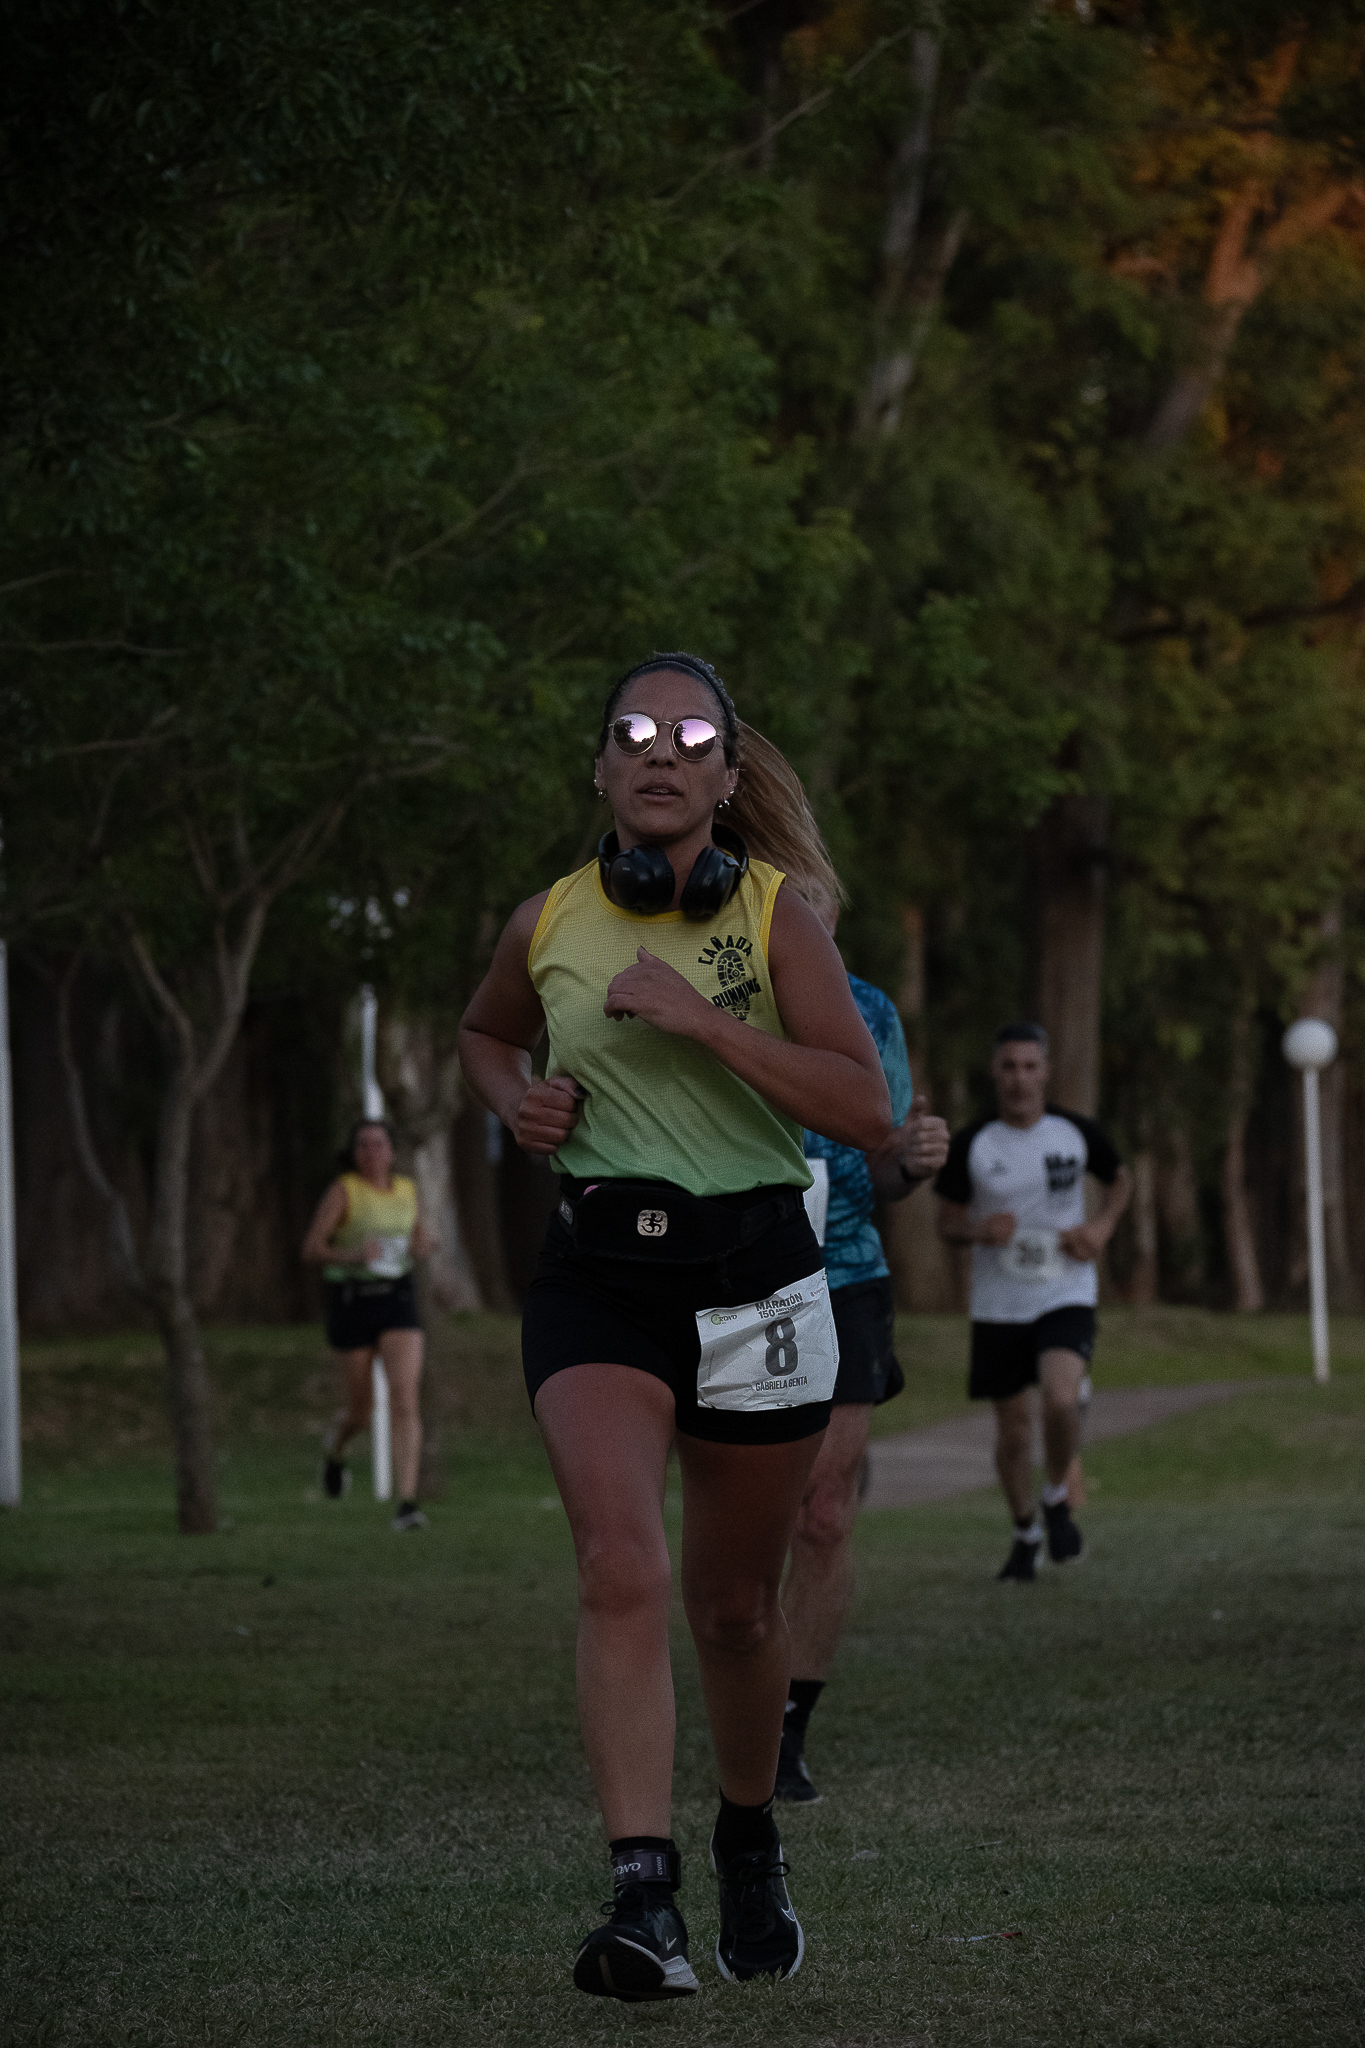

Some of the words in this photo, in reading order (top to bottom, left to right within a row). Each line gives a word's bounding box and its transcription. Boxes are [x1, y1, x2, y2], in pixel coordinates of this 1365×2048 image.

[711, 978, 761, 1009] RUNNING
[755, 1292, 803, 1312] MARATÓN
[758, 1309, 776, 1319] 150
[765, 1317, 798, 1377] 8
[755, 1378, 788, 1391] GABRIELA
[788, 1376, 808, 1387] GENTA
